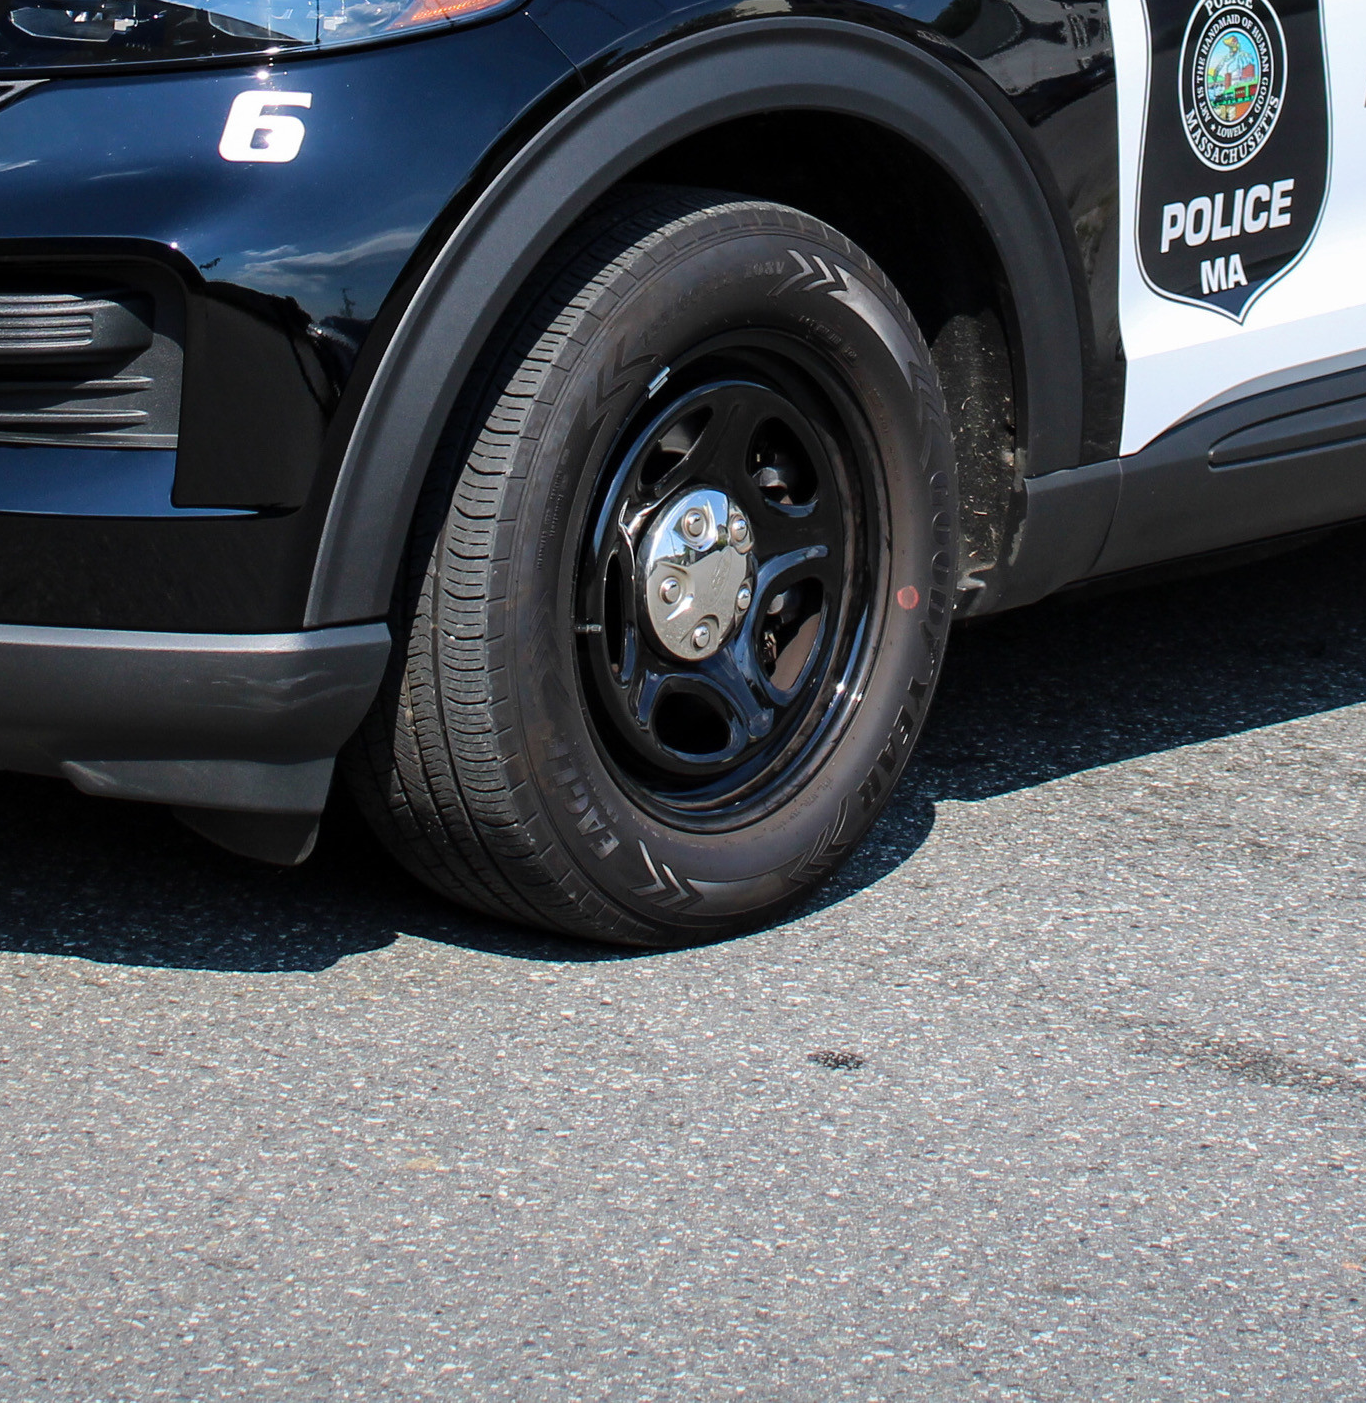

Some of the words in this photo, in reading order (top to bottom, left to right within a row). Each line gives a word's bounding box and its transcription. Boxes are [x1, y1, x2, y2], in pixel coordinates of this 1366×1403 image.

[1203, 14, 1241, 57] HANDMAID
[1241, 17, 1254, 30] OF
[1251, 26, 1270, 73] HUMAN
[1195, 57, 1206, 84] THE
[1196, 85, 1205, 99] IS
[1198, 100, 1212, 123] ART
[1254, 77, 1269, 115] GOOD
[218, 89, 313, 164] 6
[1185, 95, 1280, 165] MASSACHUSETTS
[1216, 124, 1248, 139] LOWELL
[1159, 178, 1295, 254] POLICE
[1201, 254, 1249, 296] MA
